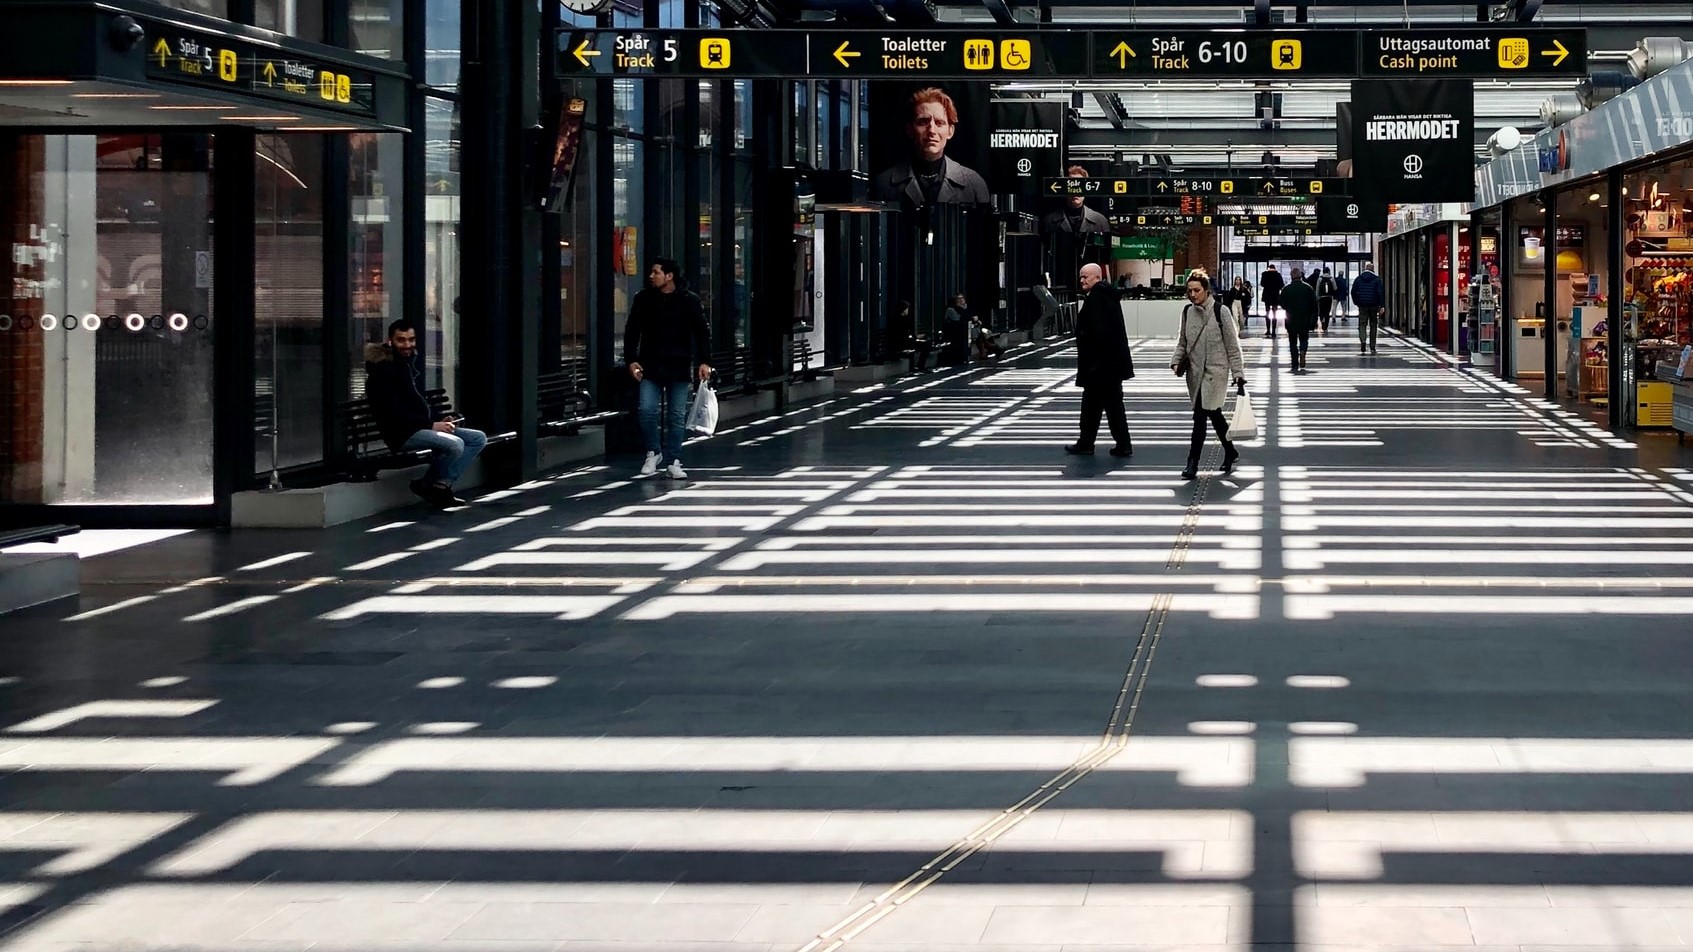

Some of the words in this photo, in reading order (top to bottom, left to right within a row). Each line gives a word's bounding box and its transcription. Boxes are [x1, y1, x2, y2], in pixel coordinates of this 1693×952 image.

[616, 35, 649, 52] Spår
[664, 40, 678, 62] 5
[882, 37, 947, 51] Toaletter
[1152, 36, 1185, 54] Spår
[1198, 41, 1247, 63] 6-10
[1380, 37, 1491, 54] Uttagsautomat
[180, 37, 200, 56] Spår
[205, 47, 213, 71] 5
[616, 53, 655, 68] Track
[882, 55, 928, 69] Toilets
[1152, 55, 1190, 69] Track
[1379, 54, 1415, 68] Cash
[1419, 55, 1458, 71] point
[180, 56, 202, 75] Track
[284, 60, 315, 79] Toaletter
[284, 77, 307, 94] Toilets
[1366, 120, 1460, 140] HERRMODET
[990, 133, 1059, 148] HERRMODET
[1067, 179, 1081, 187] Spår
[1085, 181, 1100, 191] 6-7
[1192, 181, 1212, 191] 8-10
